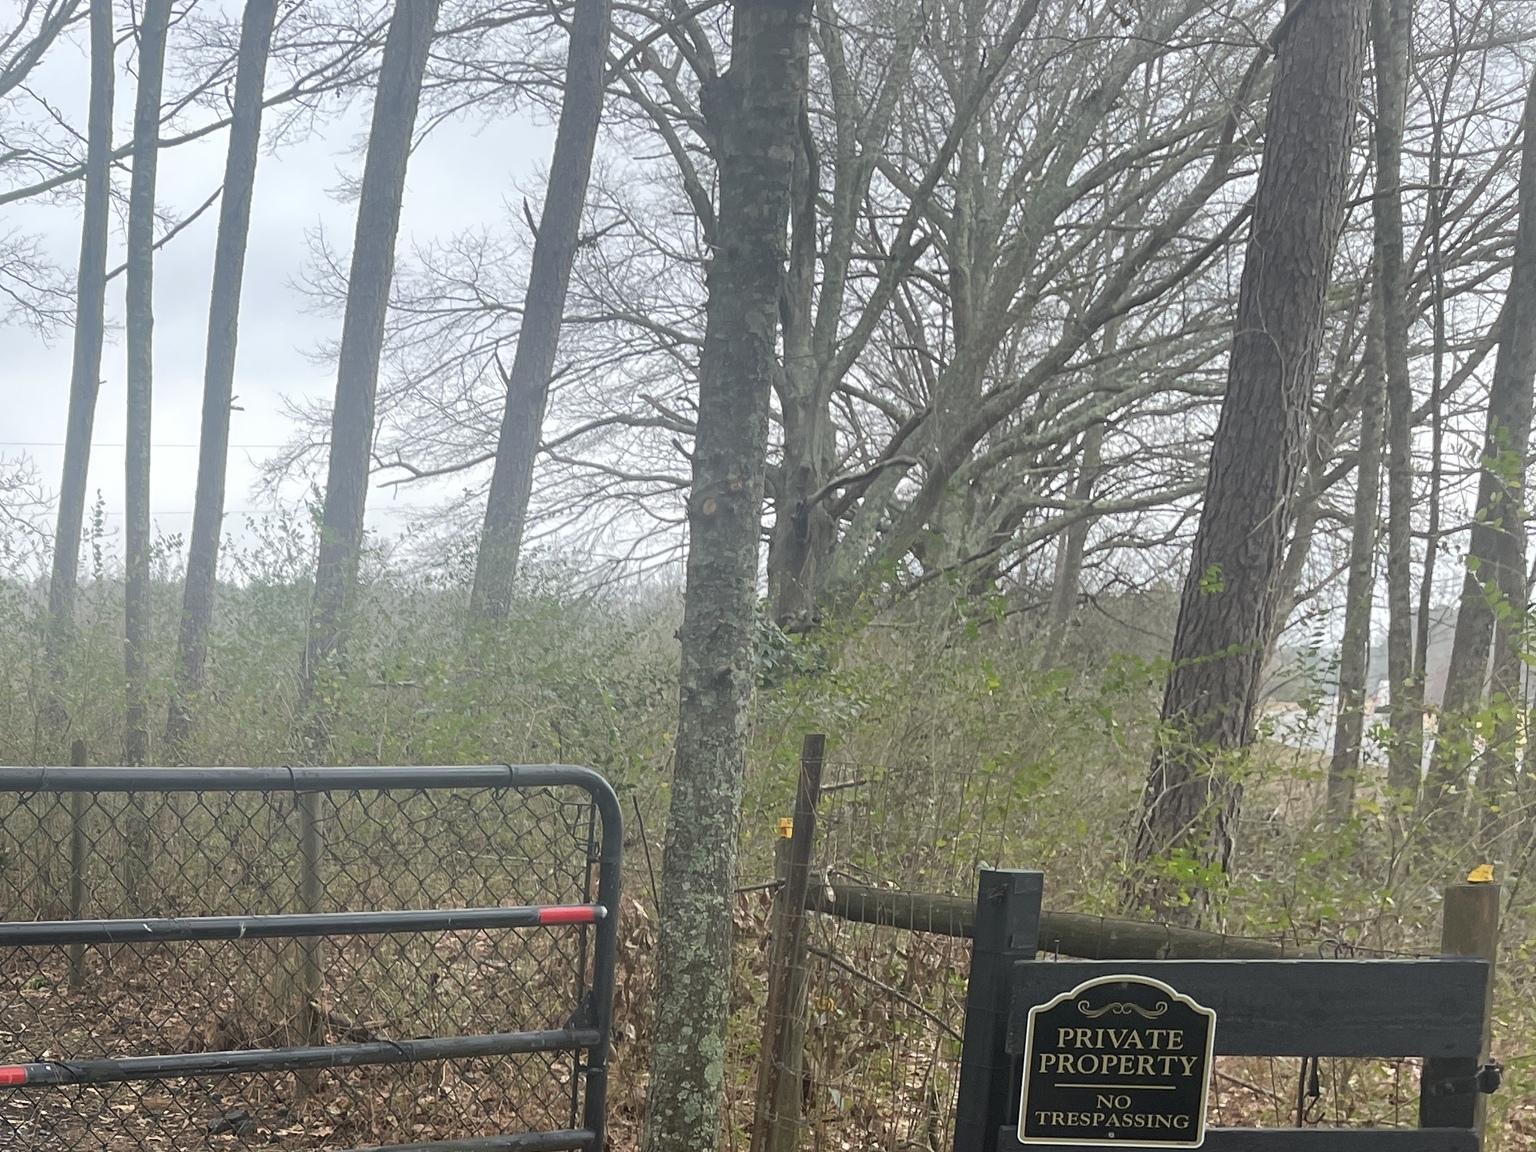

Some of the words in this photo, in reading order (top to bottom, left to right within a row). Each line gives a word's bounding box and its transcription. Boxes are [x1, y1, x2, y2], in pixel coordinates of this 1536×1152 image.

[1057, 1028, 1184, 1050] PRIVATE
[1038, 1053, 1198, 1076] PROPERTY
[1096, 1095, 1131, 1109] NO
[1035, 1111, 1189, 1129] TRESPASSING
